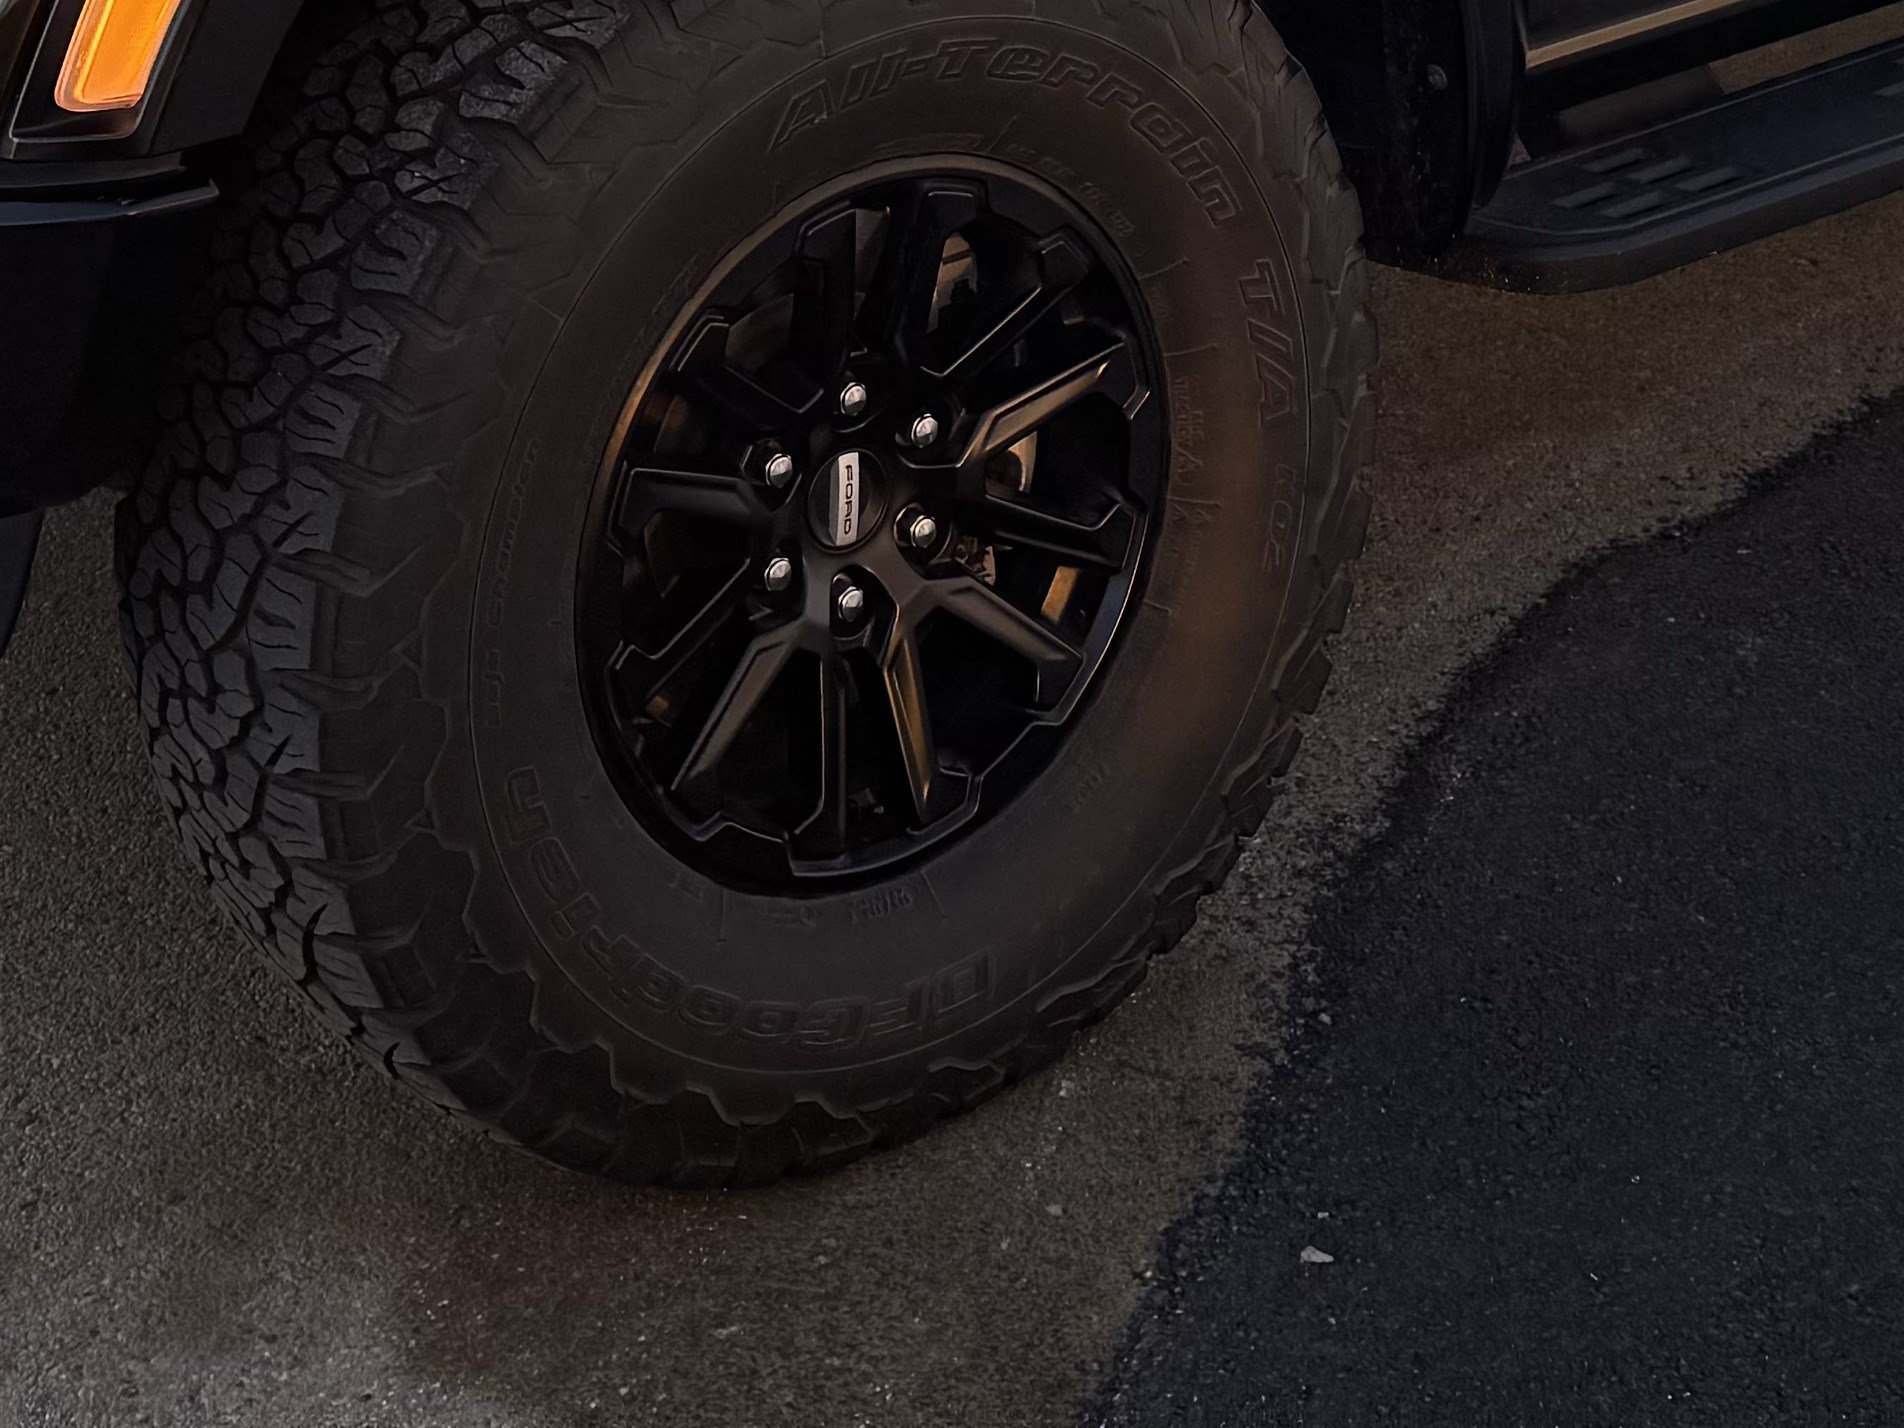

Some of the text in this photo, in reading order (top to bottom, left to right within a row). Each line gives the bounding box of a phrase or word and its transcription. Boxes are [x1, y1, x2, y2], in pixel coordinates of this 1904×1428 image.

[766, 34, 1243, 228] All-Terrain
[1238, 257, 1298, 430] T/A
[844, 465, 852, 534] FORD
